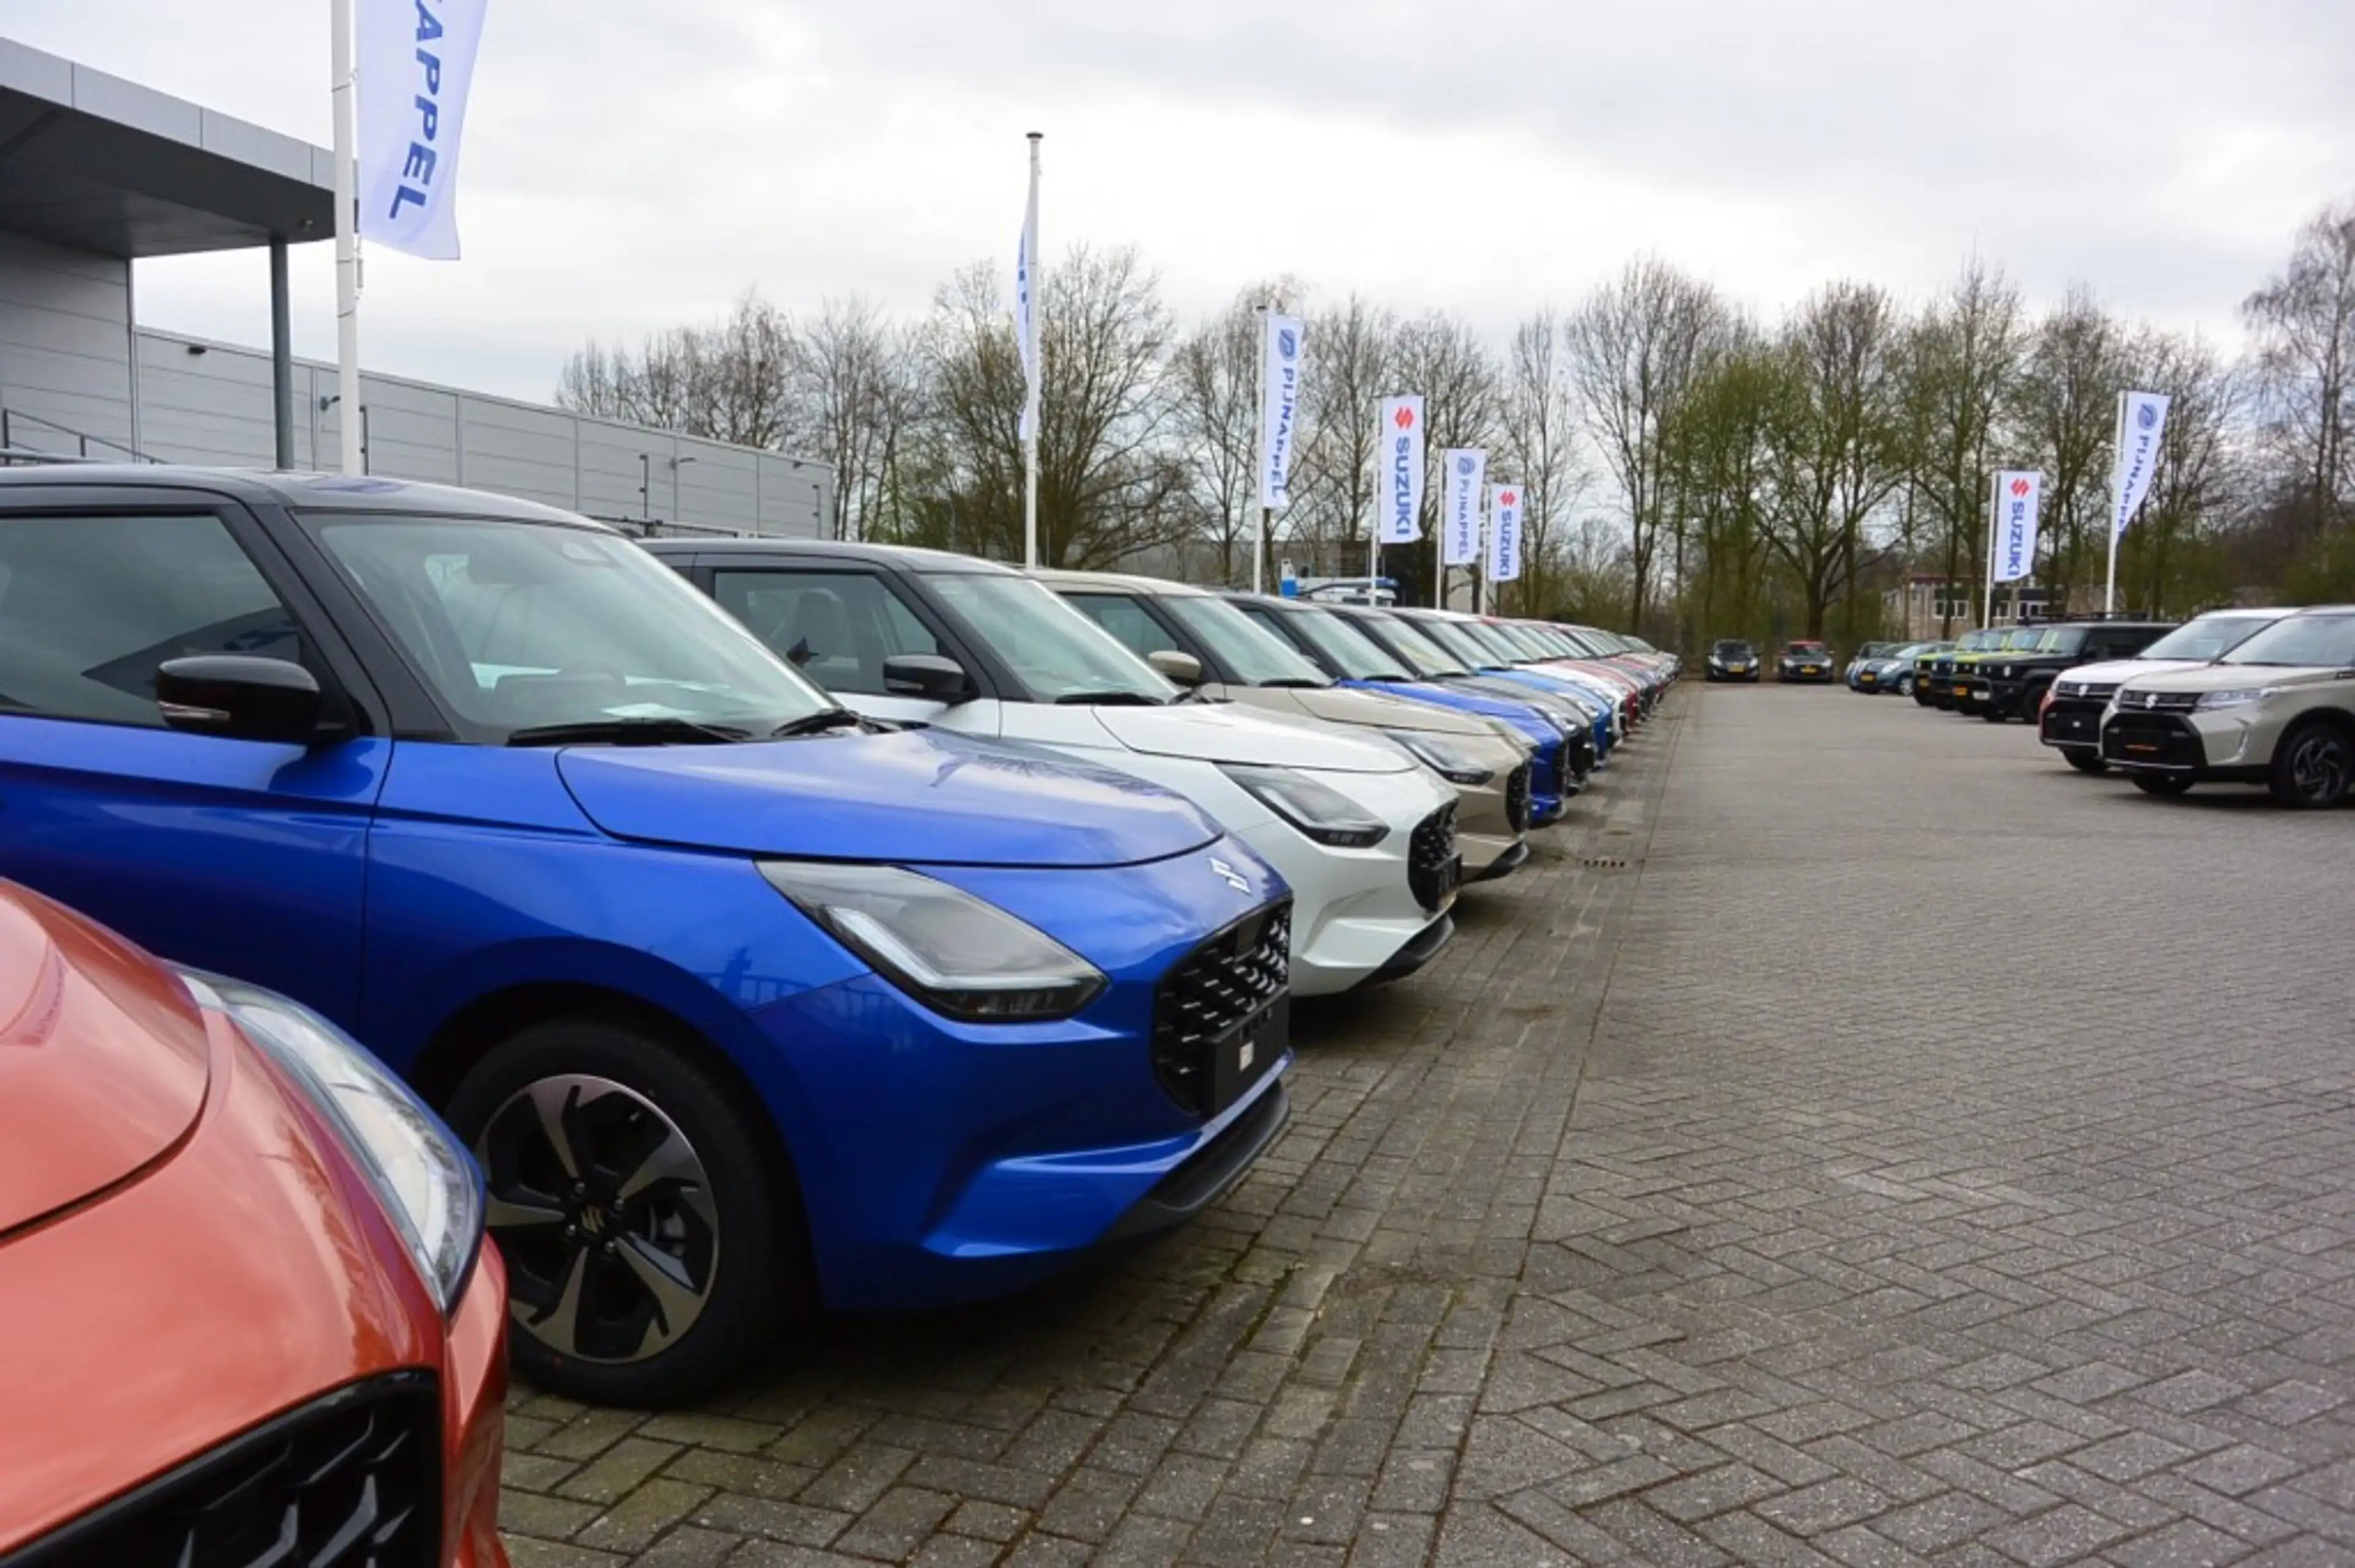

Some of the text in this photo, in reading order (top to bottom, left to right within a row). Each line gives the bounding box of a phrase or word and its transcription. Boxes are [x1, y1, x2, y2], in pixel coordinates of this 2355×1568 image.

[389, 0, 443, 219] APPEL
[1271, 367, 1295, 498] PIJNAPPEL
[1395, 437, 1411, 535] SUZUKI
[1458, 478, 1470, 560] PIJNAPPEL
[1499, 510, 1512, 576] SUZUKI
[2008, 501, 2024, 576] SUZUKI
